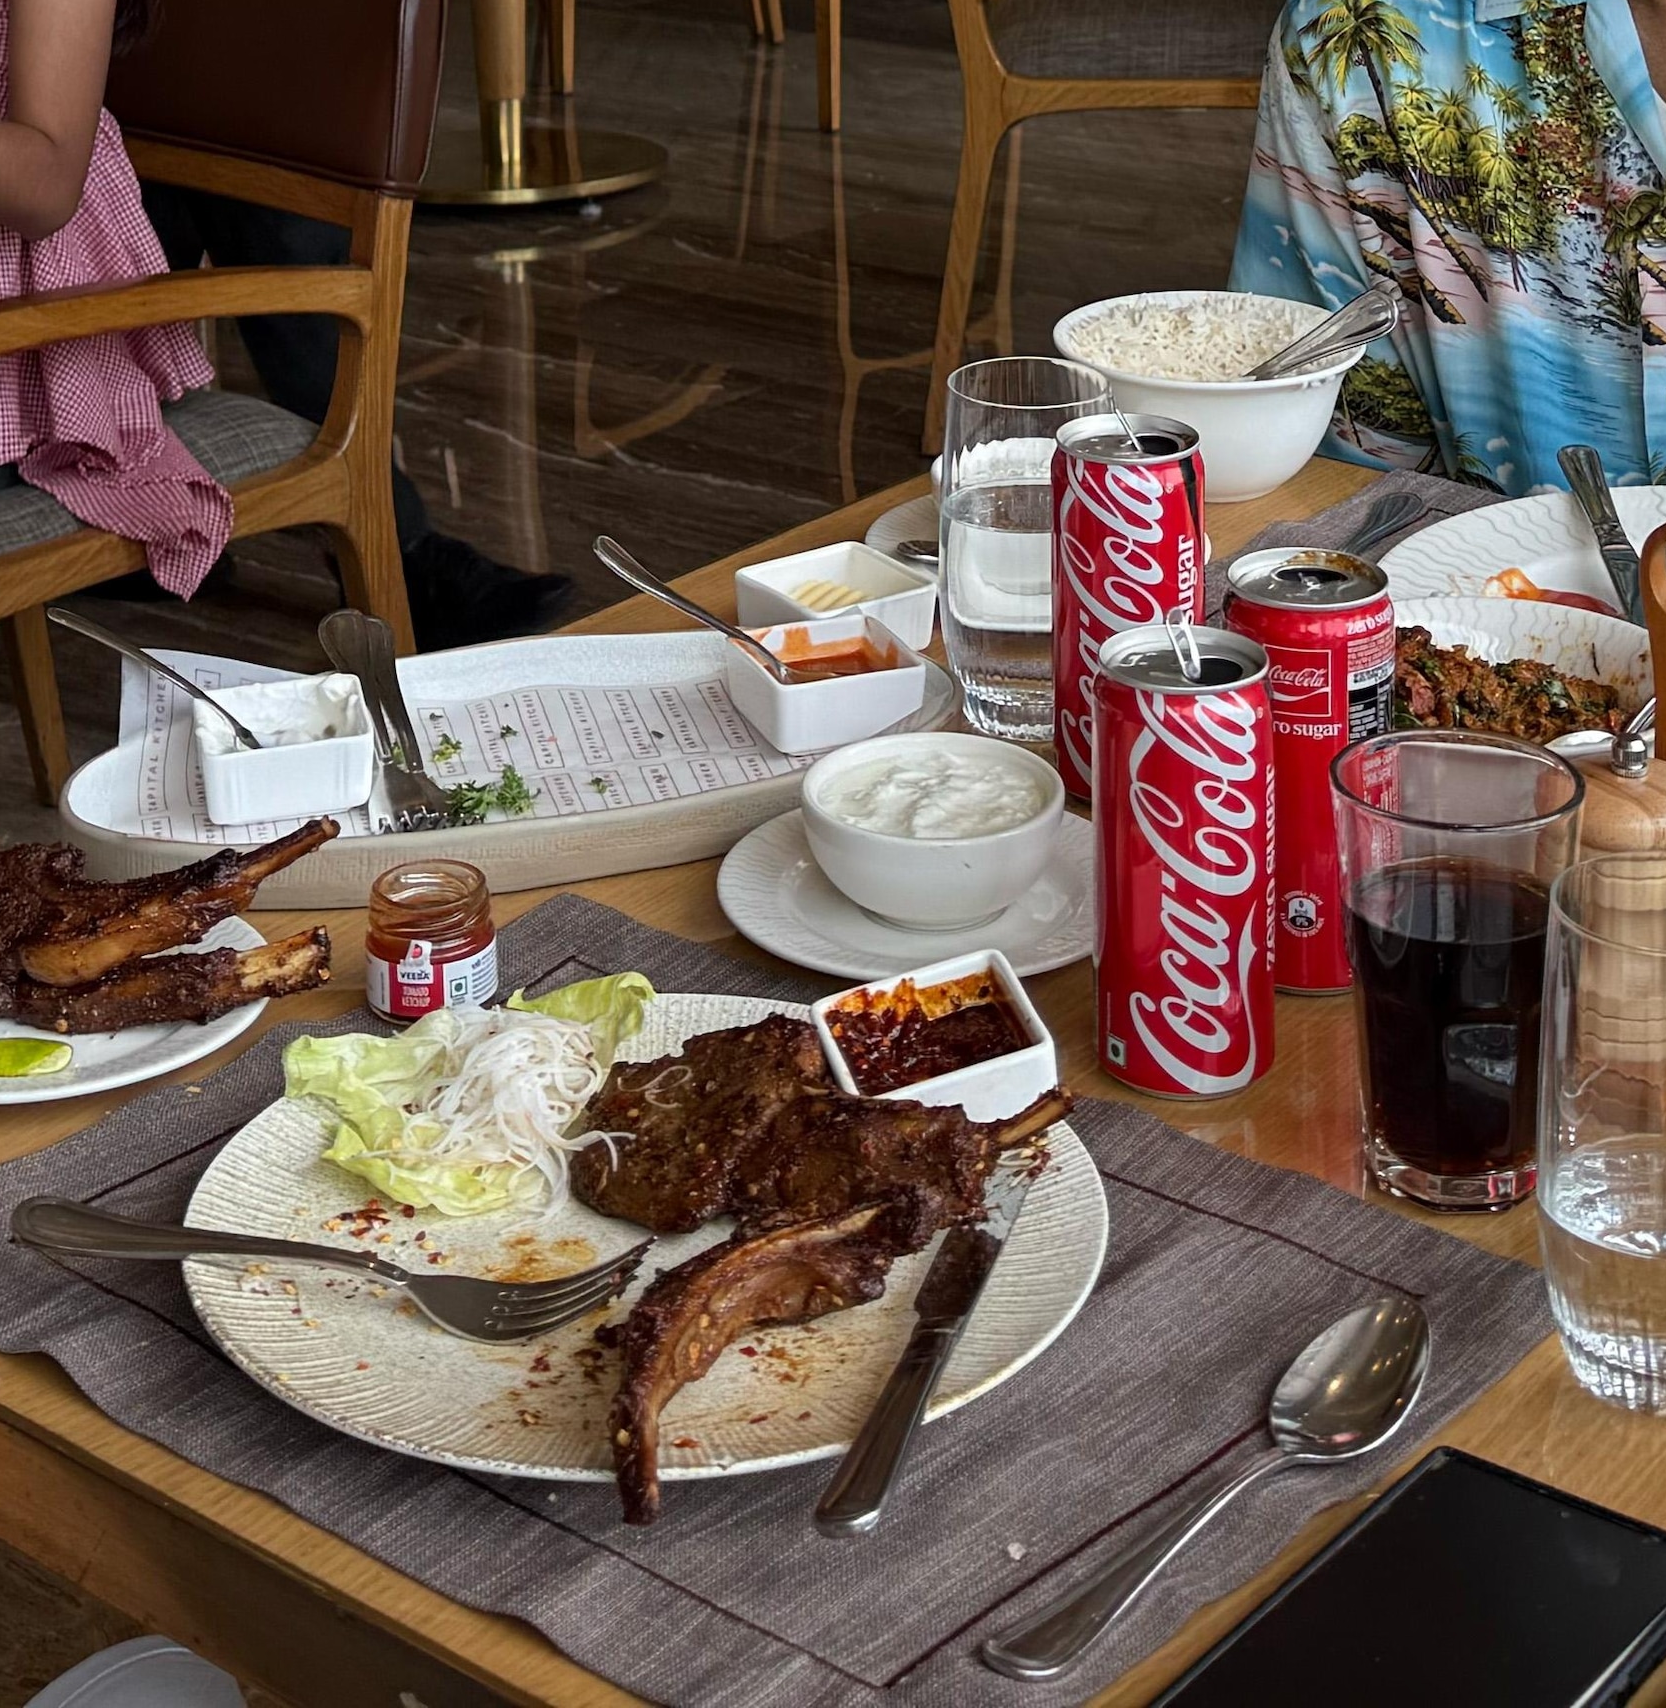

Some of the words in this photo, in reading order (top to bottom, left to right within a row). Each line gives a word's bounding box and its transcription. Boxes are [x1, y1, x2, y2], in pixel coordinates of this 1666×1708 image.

[1060, 453, 1165, 789] C-Cola
[1375, 601, 1394, 626] sug
[1273, 720, 1291, 734] ro
[1293, 722, 1342, 740] sugar
[1129, 690, 1257, 1093] Coca-Cola
